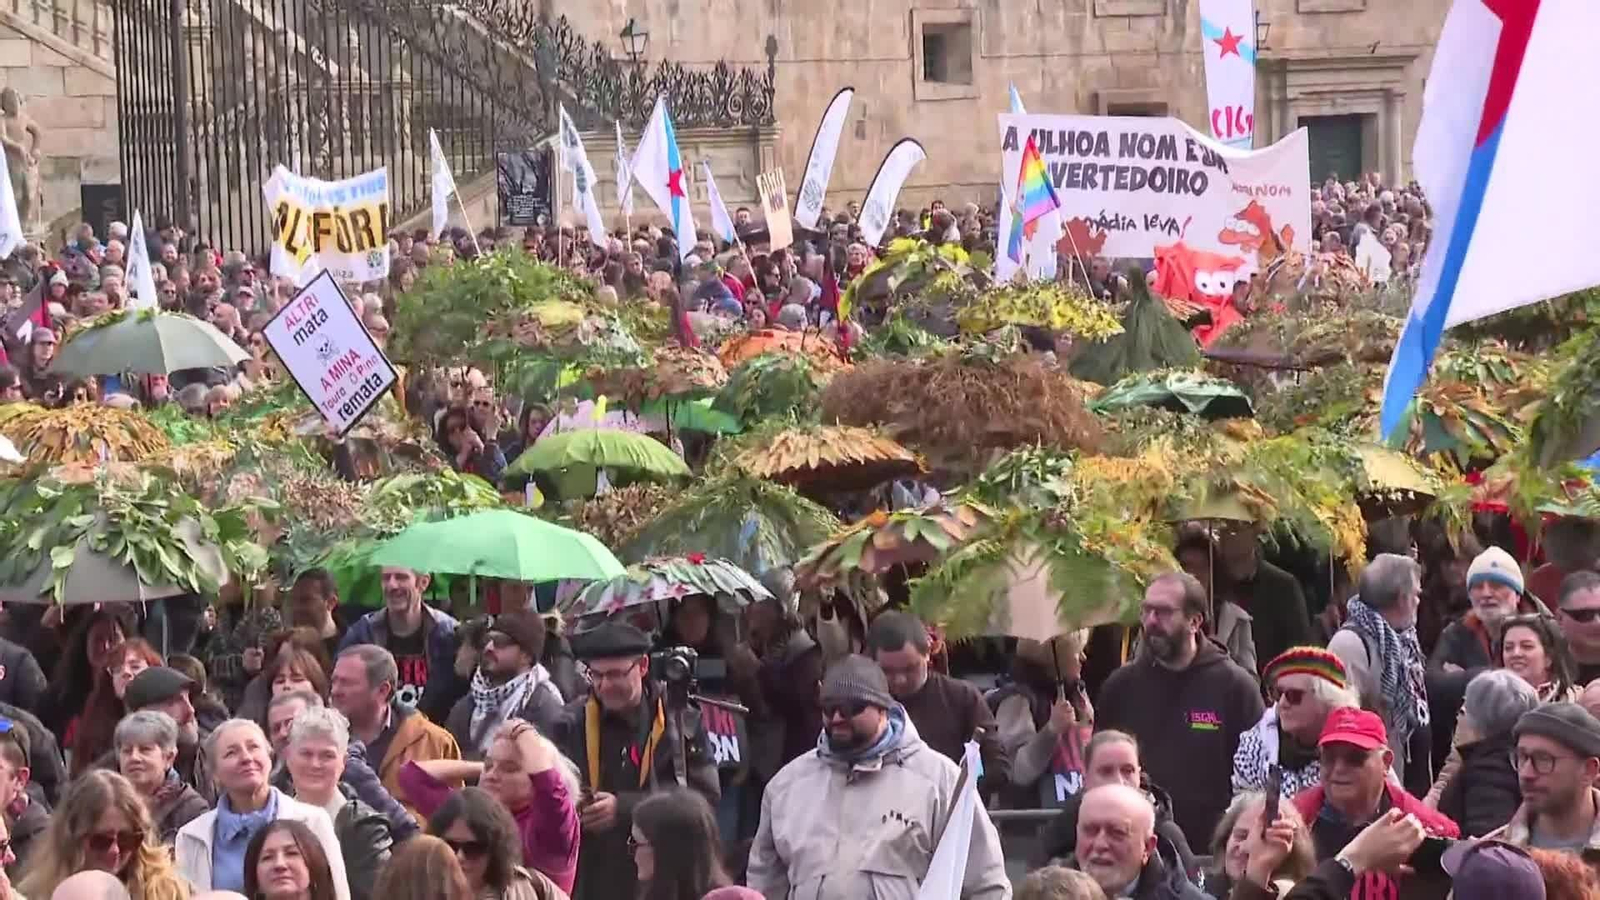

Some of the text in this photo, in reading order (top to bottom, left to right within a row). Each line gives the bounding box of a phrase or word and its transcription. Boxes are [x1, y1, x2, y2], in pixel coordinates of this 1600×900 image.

[1003, 126, 1019, 151] A
[1119, 132, 1178, 160] NOM
[1049, 162, 1209, 196] VERTEDOIRO
[284, 293, 319, 331] ALTRI
[293, 307, 329, 346] mata
[321, 349, 361, 392] A MINA
[321, 387, 346, 412] Touro
[337, 372, 383, 422] remata
